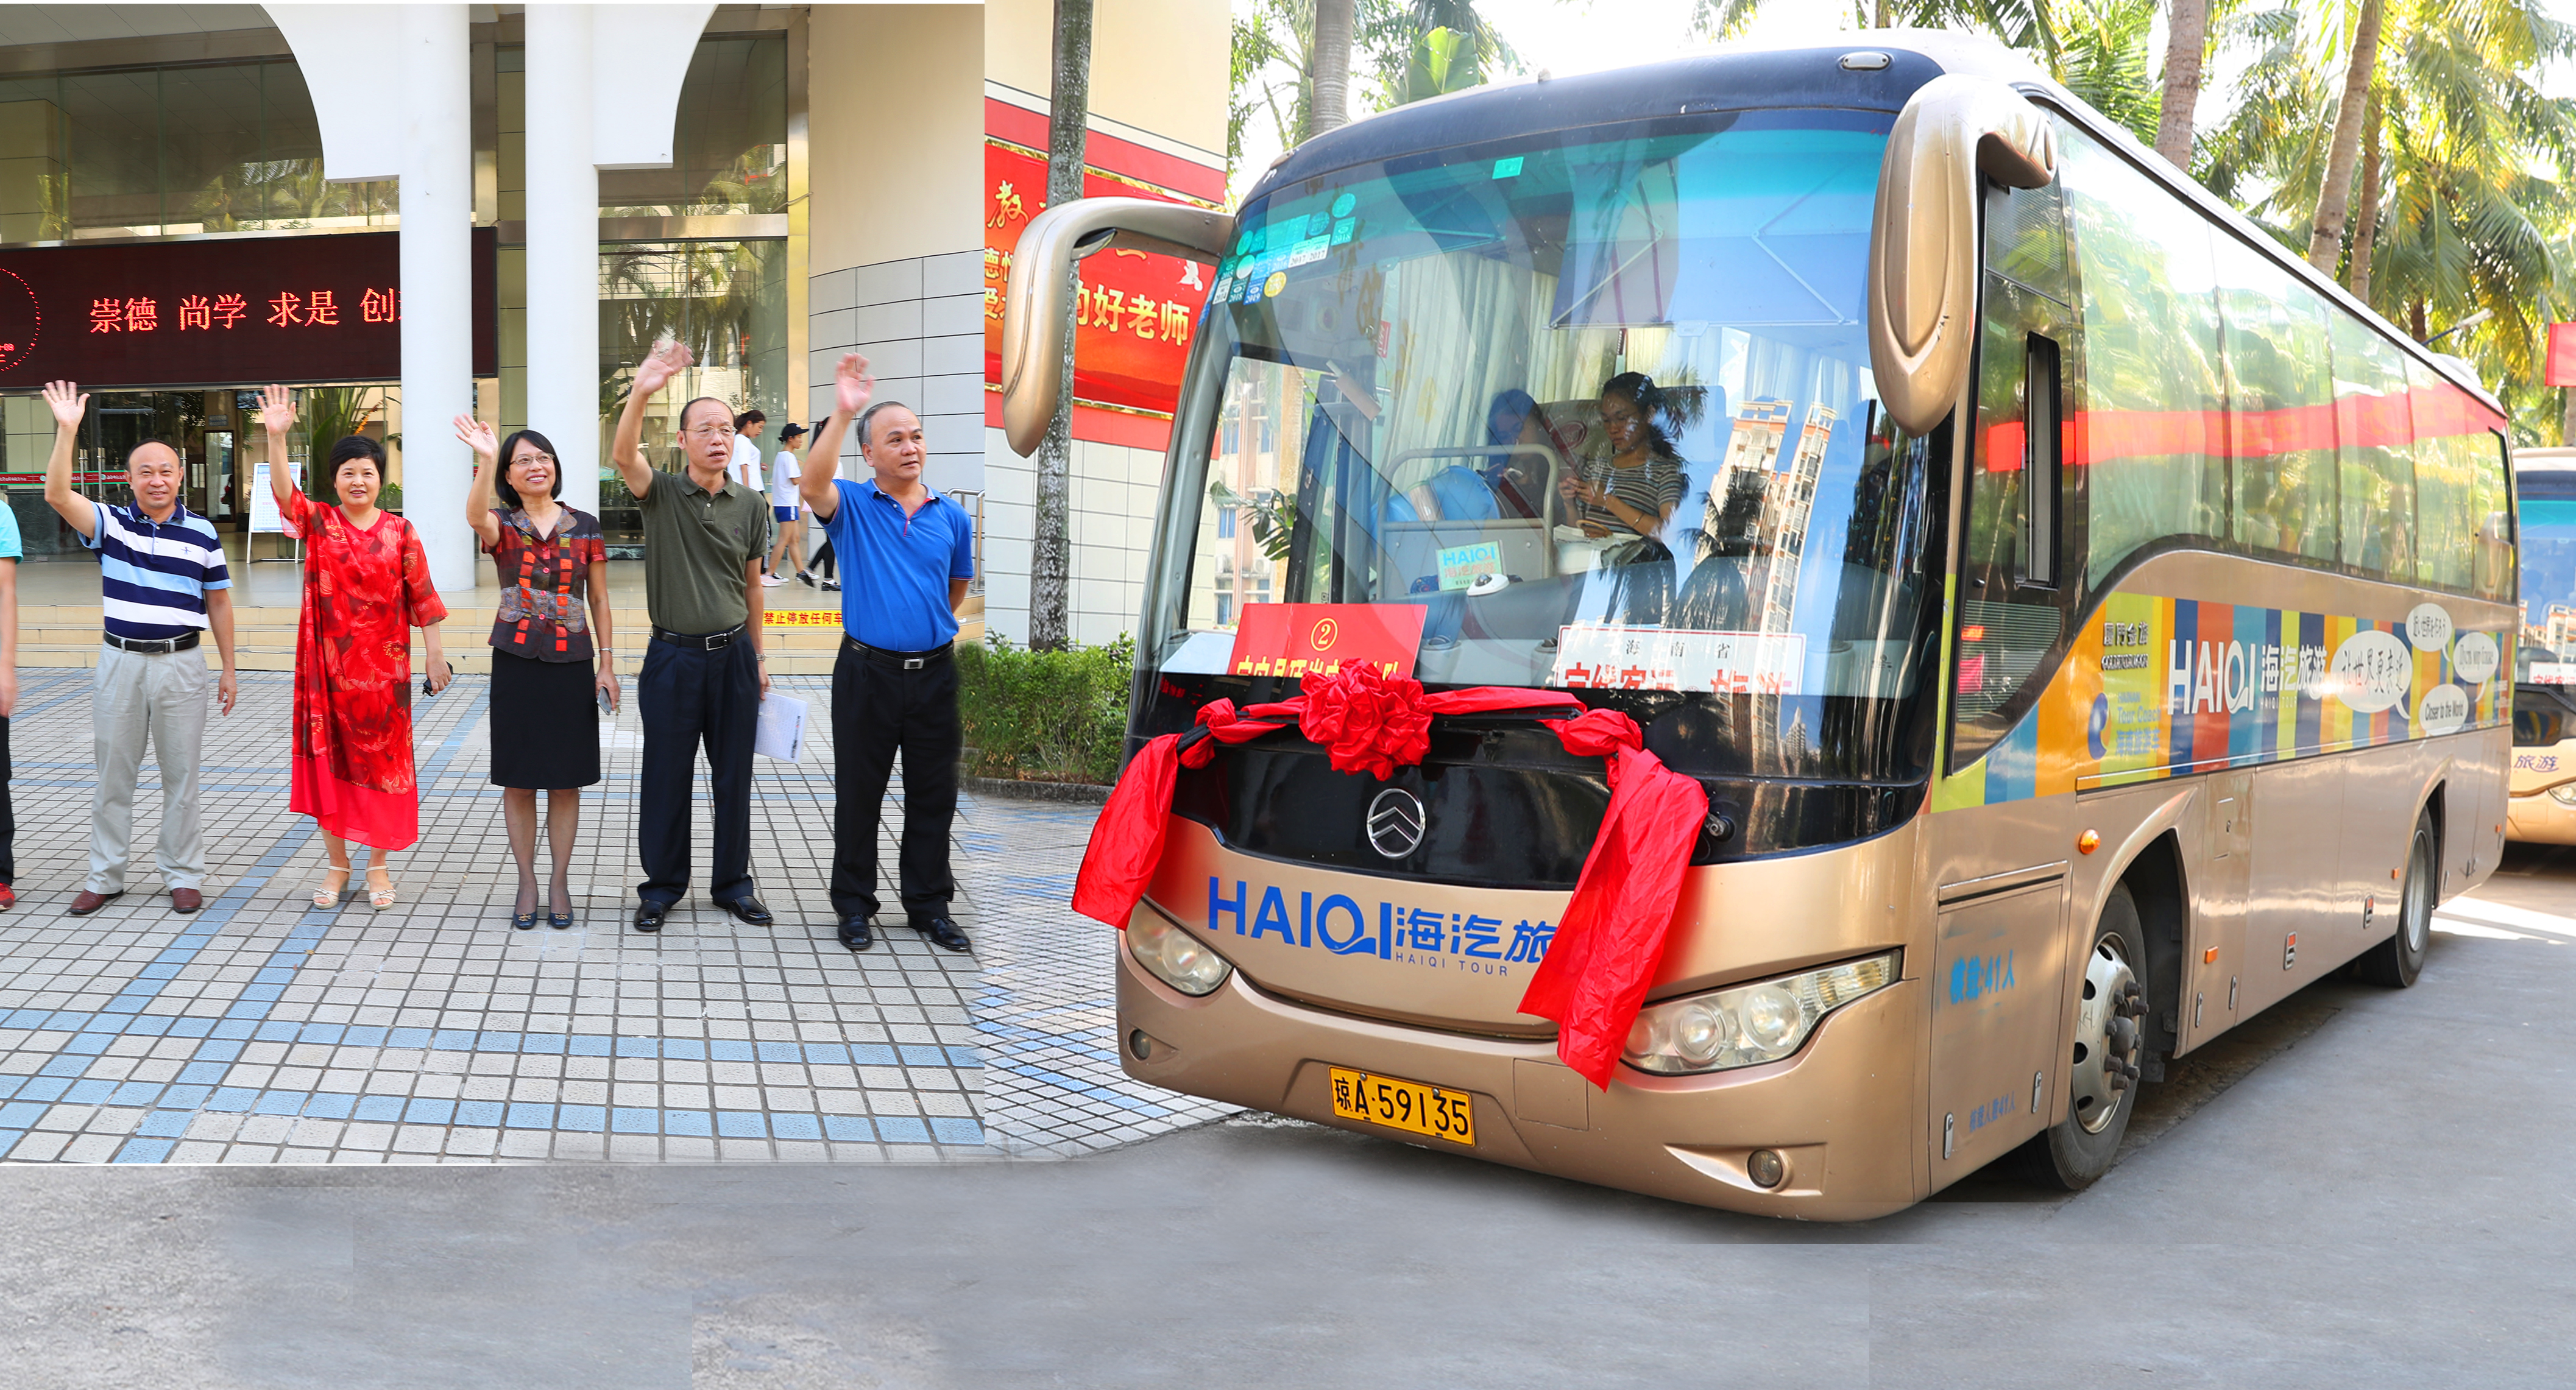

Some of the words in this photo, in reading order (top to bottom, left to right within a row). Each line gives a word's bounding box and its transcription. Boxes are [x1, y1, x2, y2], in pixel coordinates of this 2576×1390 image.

[90, 297, 158, 333] 崇德
[179, 293, 247, 331] 尚学
[266, 290, 340, 328] 求是
[359, 288, 403, 323] 创
[763, 612, 843, 624] 禁止停放任何车
[2167, 639, 2256, 715] HAIQI
[2260, 644, 2327, 700] 海汽旅游
[2117, 706, 2135, 724] Tour
[2137, 704, 2161, 723] Coach
[2425, 703, 2440, 721] Closer
[2440, 702, 2444, 719] to
[2513, 755, 2560, 773] 旅游
[1208, 877, 1392, 960] HAIQI
[1395, 952, 1446, 968] HAIQI
[1459, 961, 1508, 976] TOUR
